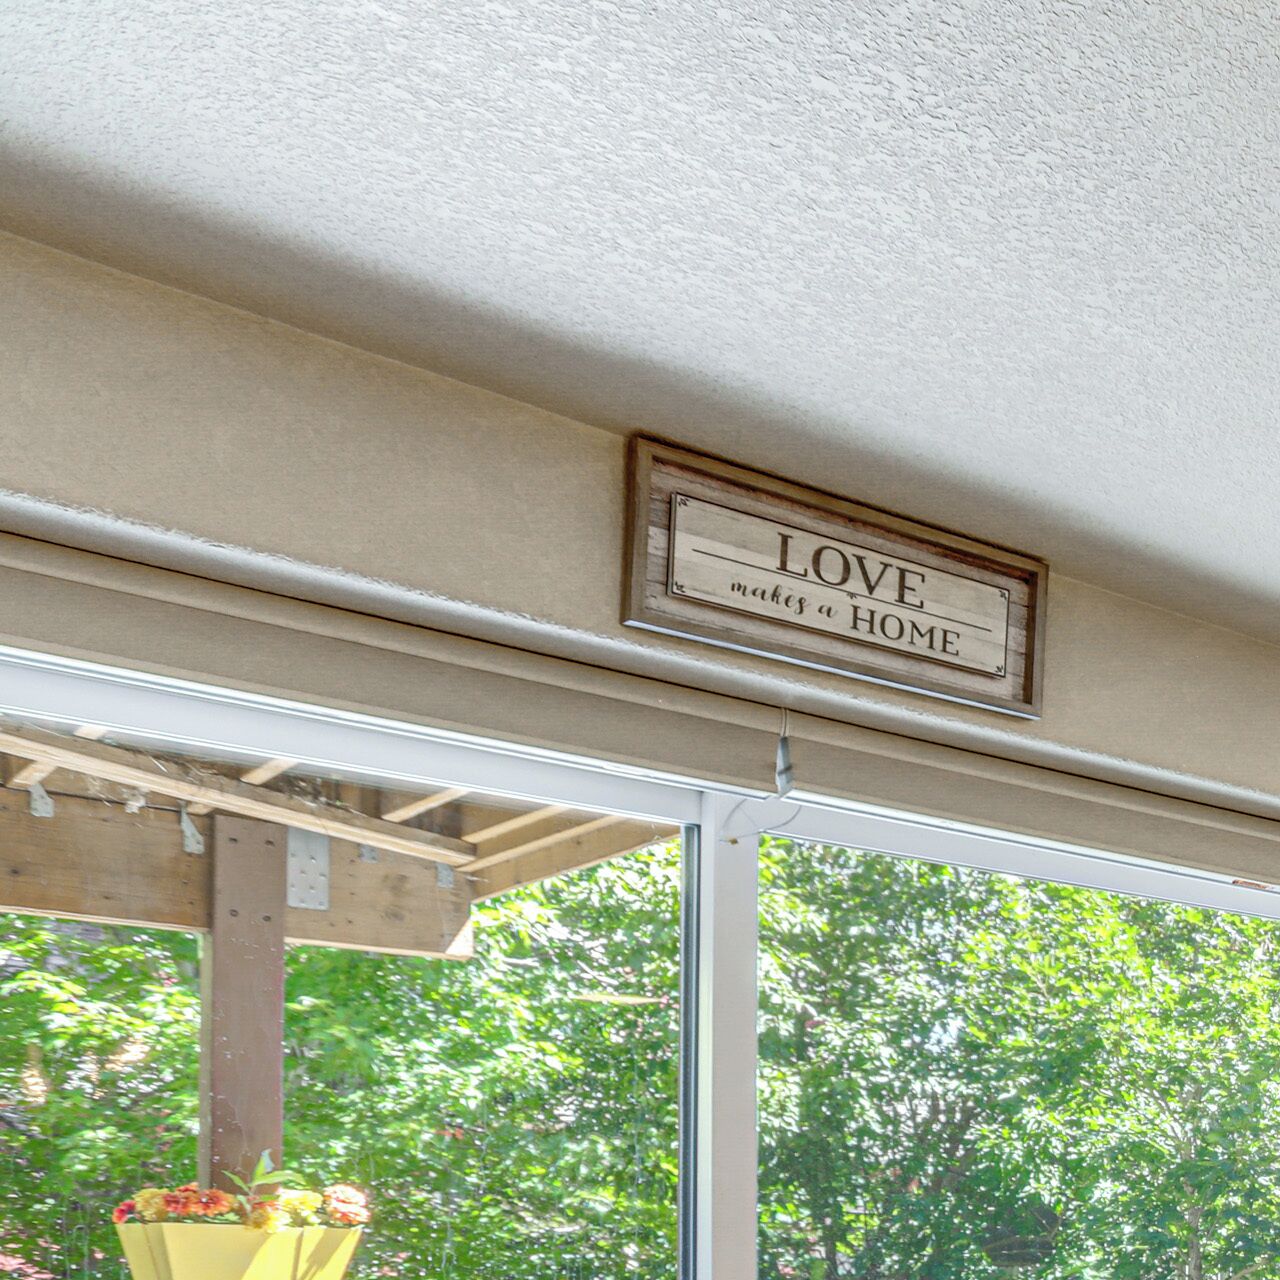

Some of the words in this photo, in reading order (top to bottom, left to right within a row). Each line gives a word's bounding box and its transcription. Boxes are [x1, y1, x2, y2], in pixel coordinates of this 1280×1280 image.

[776, 531, 926, 609] LOVE
[730, 580, 810, 615] makes
[817, 603, 838, 618] a
[850, 604, 961, 657] HOME
